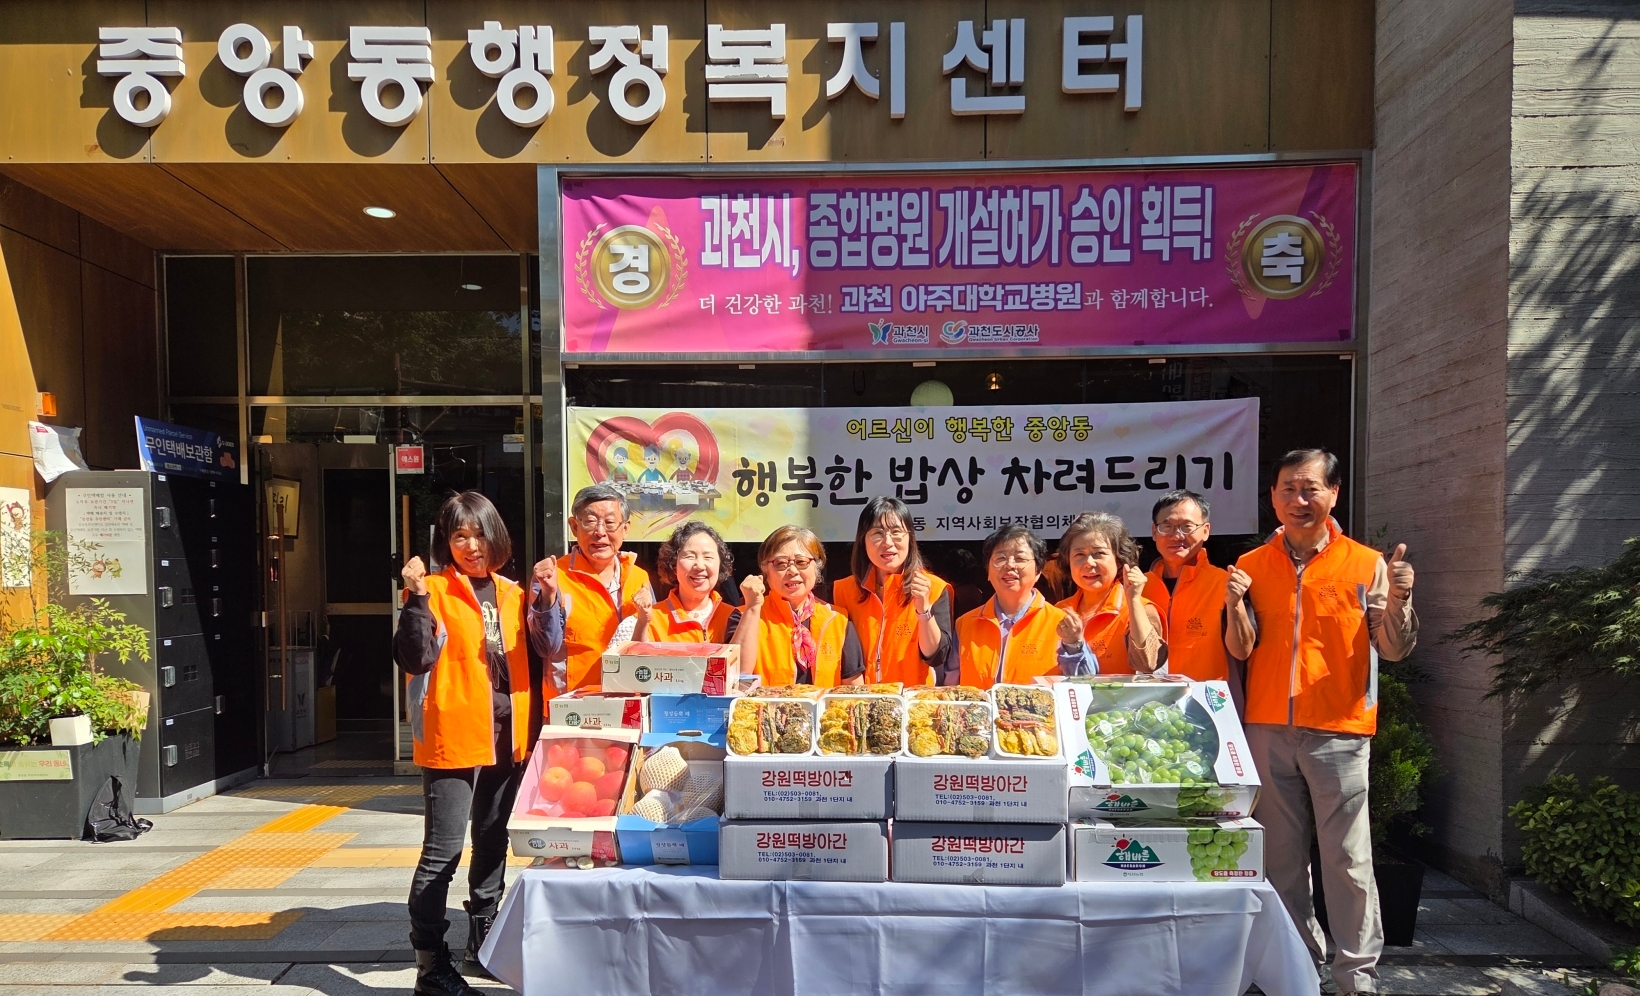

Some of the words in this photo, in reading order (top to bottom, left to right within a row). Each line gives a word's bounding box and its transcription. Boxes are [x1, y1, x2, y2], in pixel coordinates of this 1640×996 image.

[97, 15, 1142, 127] 중앙동행정복지센터
[700, 192, 799, 277] 과천시,
[808, 191, 930, 268] 종합병원
[938, 188, 1062, 267] 개설허가
[1070, 186, 1131, 264] 승인
[1141, 185, 1214, 262] 획득!
[1260, 232, 1305, 284] 축
[609, 244, 651, 294] 경
[699, 294, 715, 315] 더
[724, 293, 782, 315] 건강한
[788, 293, 833, 315] 과천!
[841, 285, 893, 313] 과천
[1110, 286, 1215, 310] 함께합니다.
[894, 325, 929, 338] 과천시
[969, 324, 1039, 337] 과천도시공사
[846, 417, 934, 442] 어르신이
[946, 416, 1014, 443] 행복한
[1024, 415, 1093, 441] 중앙동
[145, 436, 213, 464] 무인택배보관함
[732, 455, 873, 507] 행복한
[889, 456, 985, 504] 밥상
[1001, 451, 1234, 495] 차려드리기
[653, 671, 673, 682] 사과
[583, 716, 602, 726] 사과
[761, 770, 853, 788] 강원떡방아간
[933, 774, 1028, 793] 강원떡방아간
[549, 842, 569, 850] 사과
[756, 832, 847, 849] 강원떡방아간
[931, 835, 1025, 854] 강원떡방아간
[1115, 849, 1150, 861] 해바른
